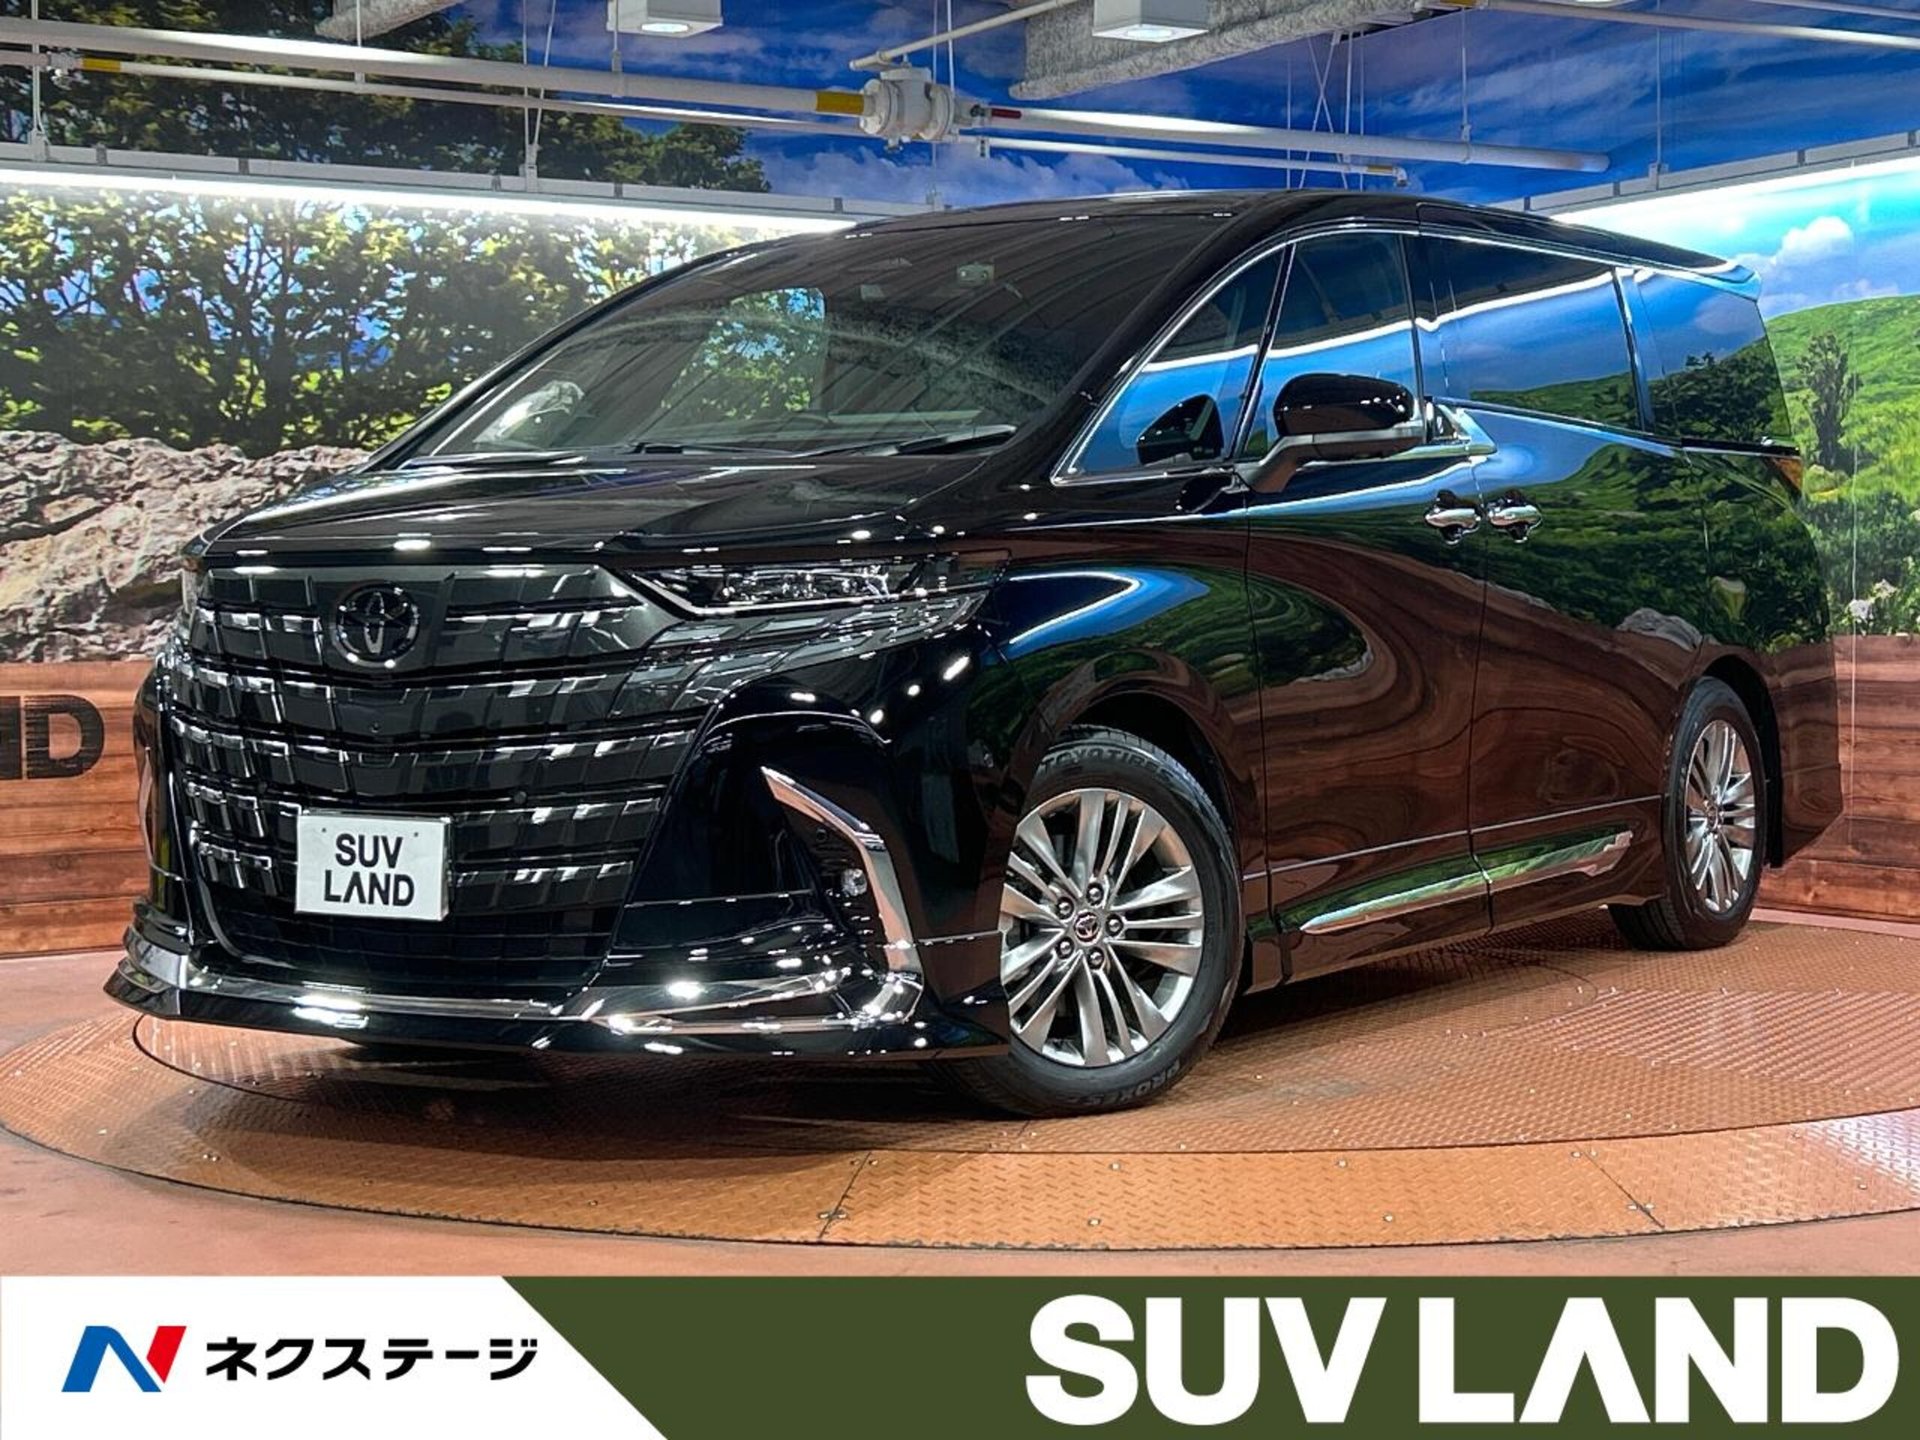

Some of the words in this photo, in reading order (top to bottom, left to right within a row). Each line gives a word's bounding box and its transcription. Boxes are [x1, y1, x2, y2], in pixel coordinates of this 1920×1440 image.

[0, 694, 104, 780] D
[336, 834, 402, 868] SUV
[324, 870, 414, 906] LAND
